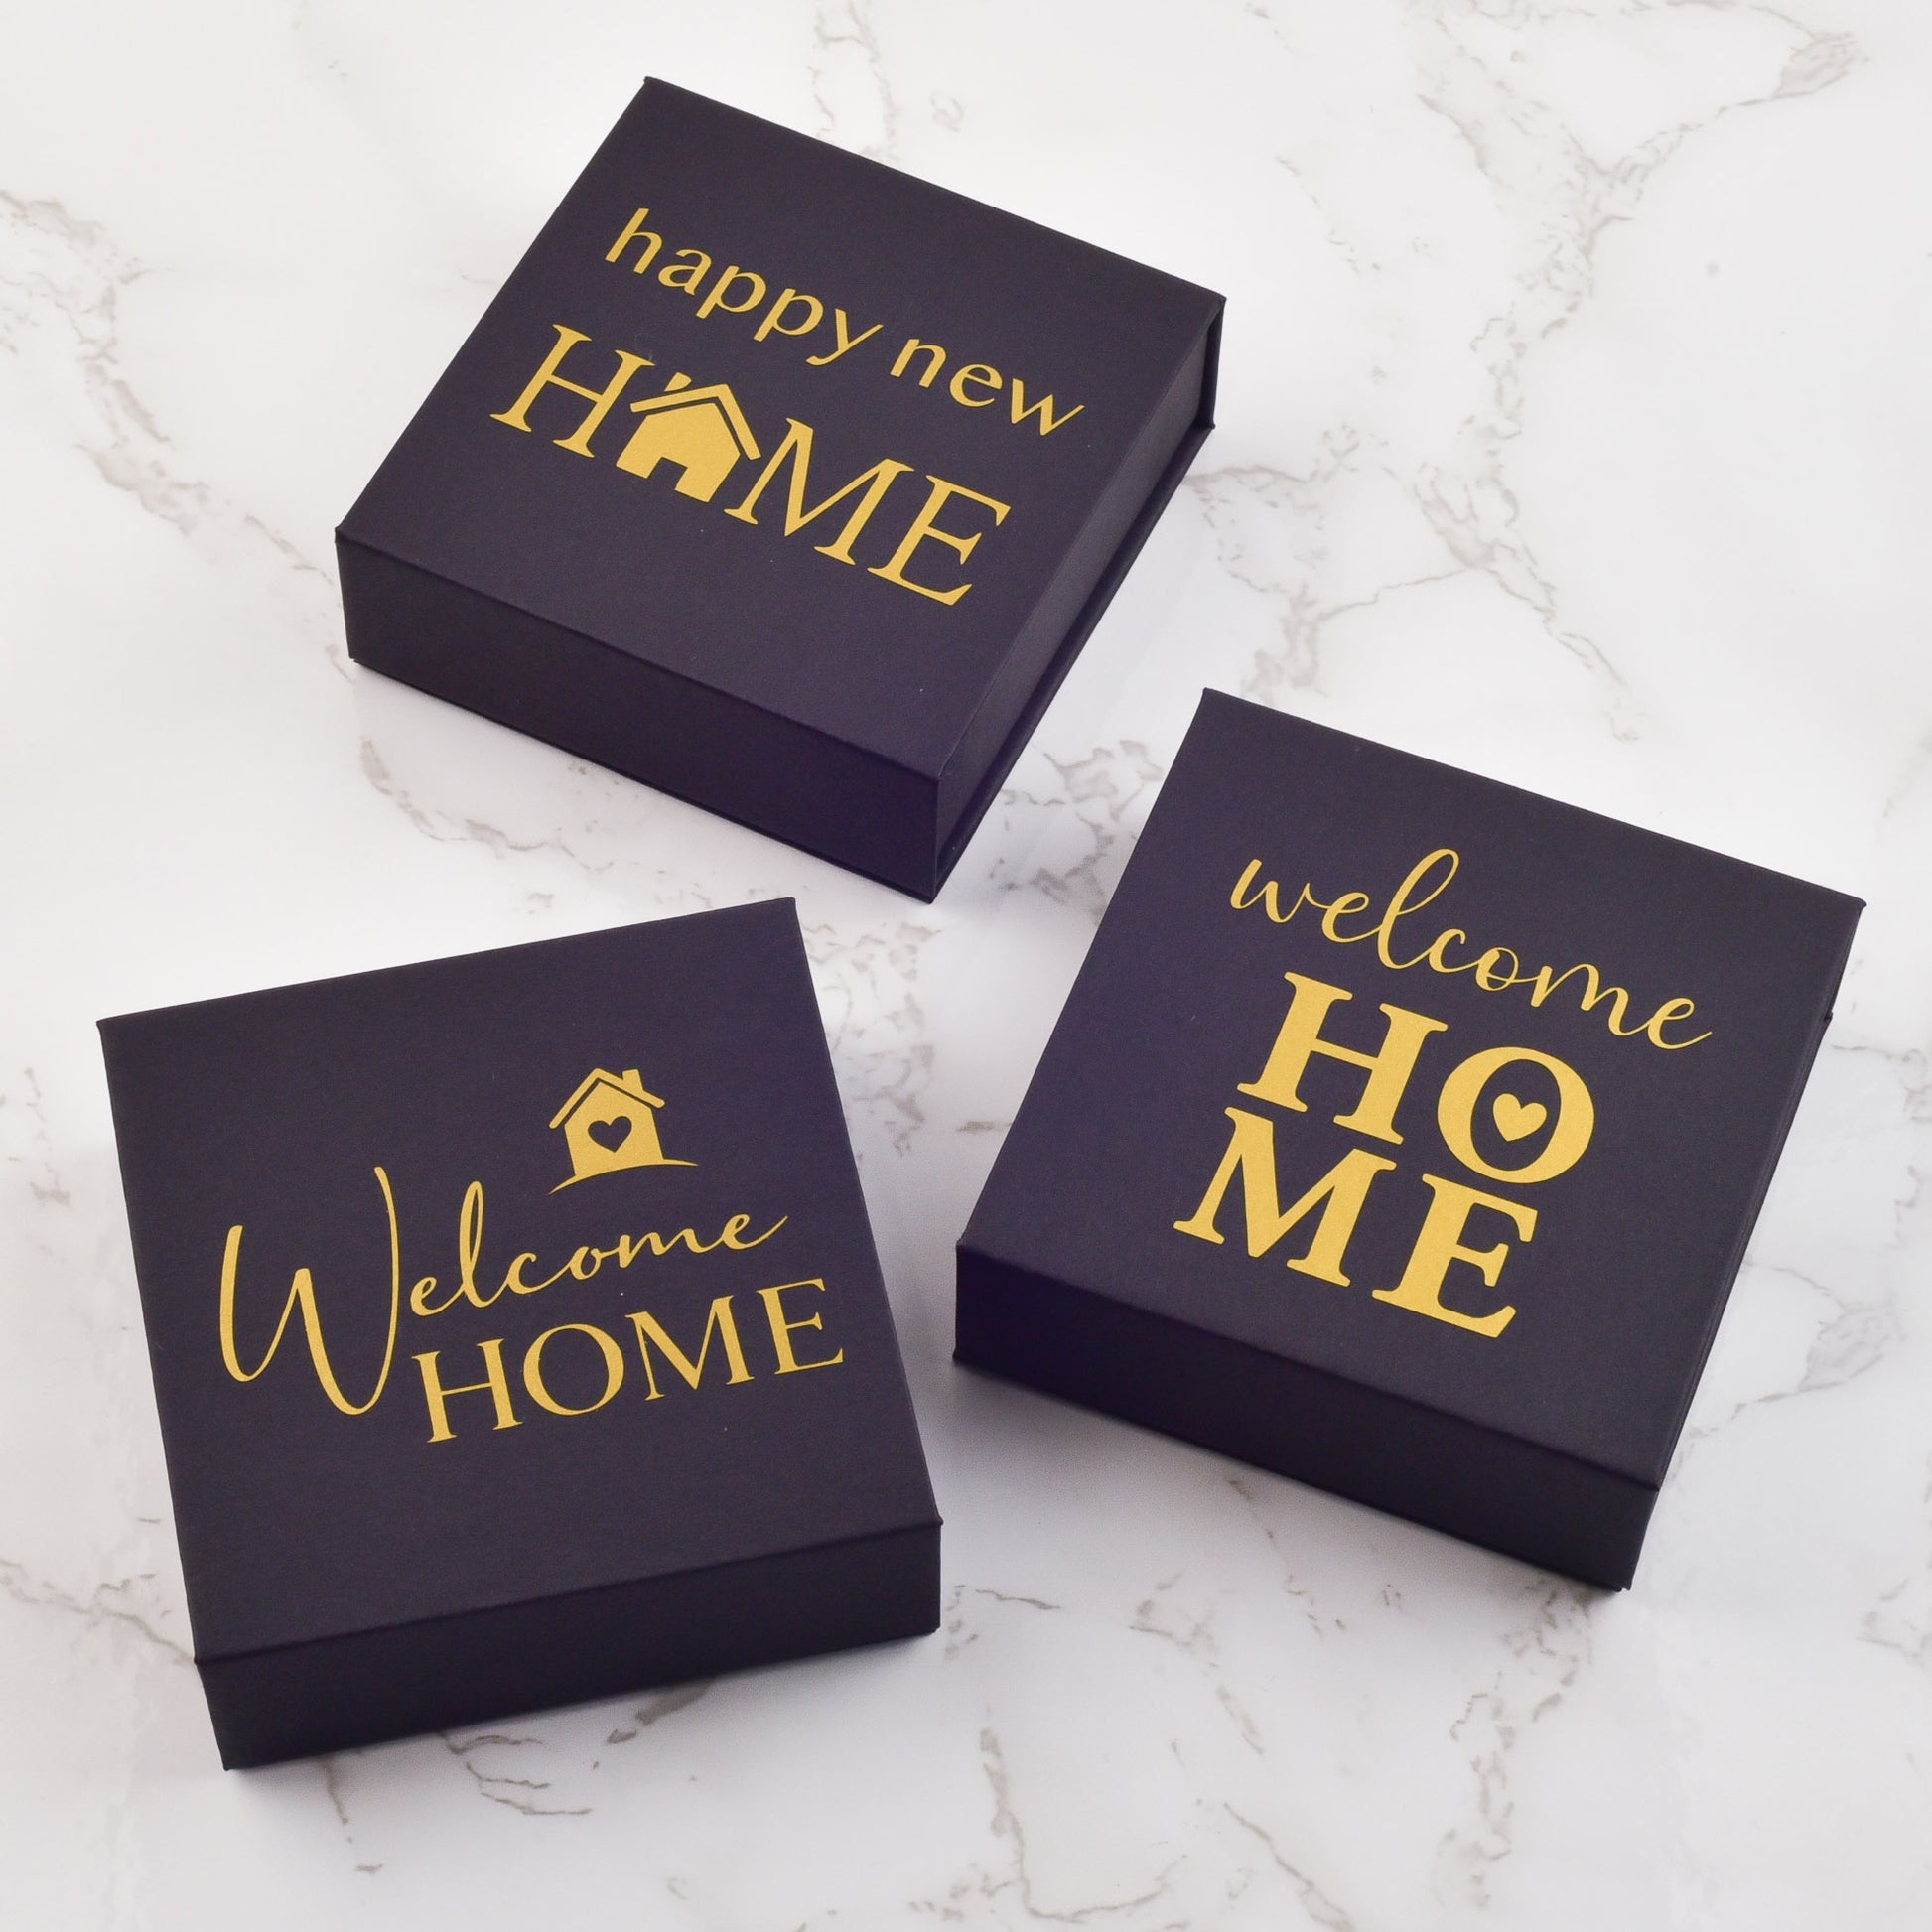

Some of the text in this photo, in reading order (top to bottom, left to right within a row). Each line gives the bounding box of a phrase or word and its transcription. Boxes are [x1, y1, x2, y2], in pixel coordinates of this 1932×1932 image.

[604, 207, 1084, 437] happy new
[1229, 848, 1713, 1050] welcome
[1236, 971, 1597, 1185] HO
[218, 1165, 788, 1416] Welcome
[1173, 1106, 1539, 1339] ME
[412, 1277, 844, 1444] HOME
